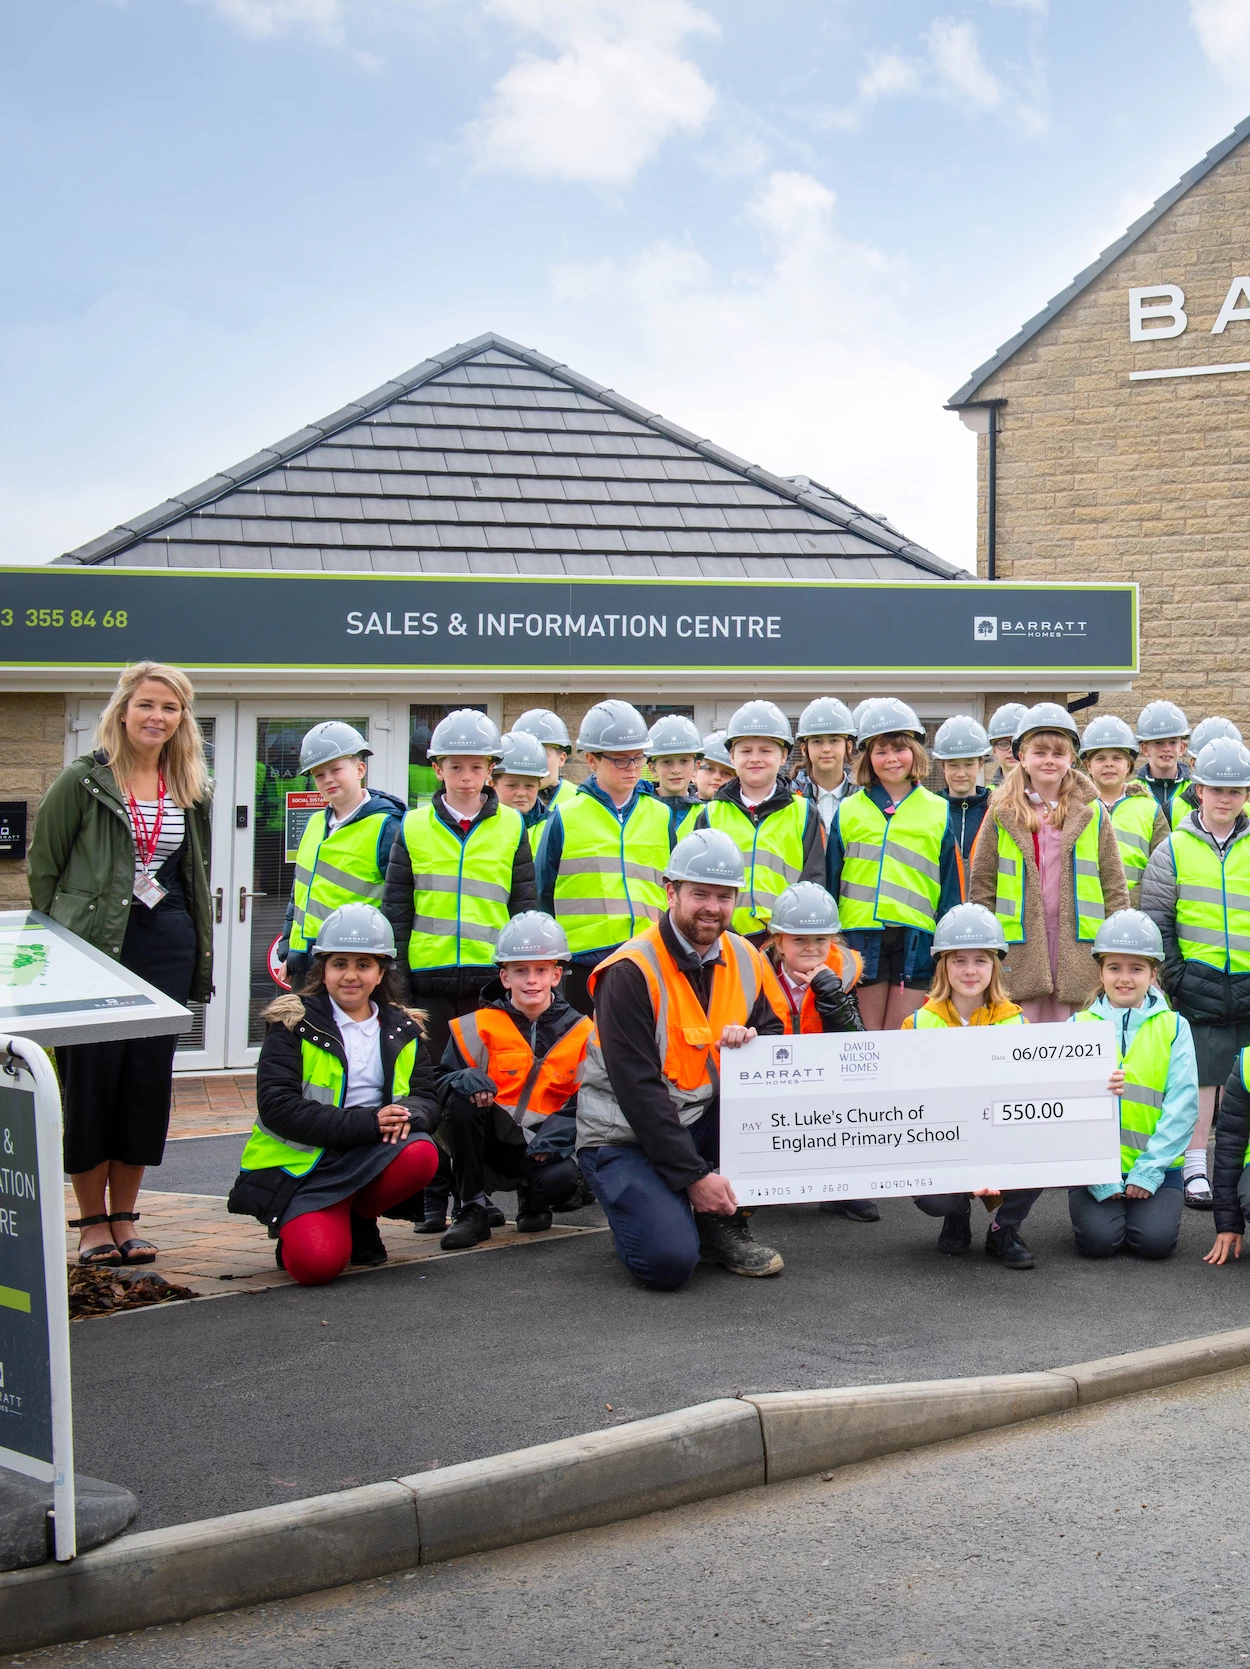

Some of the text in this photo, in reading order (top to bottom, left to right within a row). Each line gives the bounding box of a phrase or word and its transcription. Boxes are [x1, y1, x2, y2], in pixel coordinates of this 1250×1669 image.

[26, 609, 64, 627] 355
[70, 610, 96, 628] 84
[102, 610, 128, 628] 68
[346, 612, 782, 638] SALES & INFORMATION CENTRE
[1002, 621, 1087, 630] BARRATT
[844, 1042, 875, 1052] DAVID
[1012, 1044, 1101, 1060] 06/07/2021
[839, 1051, 880, 1062] WILSON
[740, 1068, 825, 1080] BARRATT
[841, 1062, 878, 1073] HOMES
[742, 1105, 924, 1131] PAY St. Luke's Church of
[982, 1102, 1063, 1121] £ 550.00
[4, 1128, 14, 1154] &
[772, 1126, 960, 1152] England Primary School
